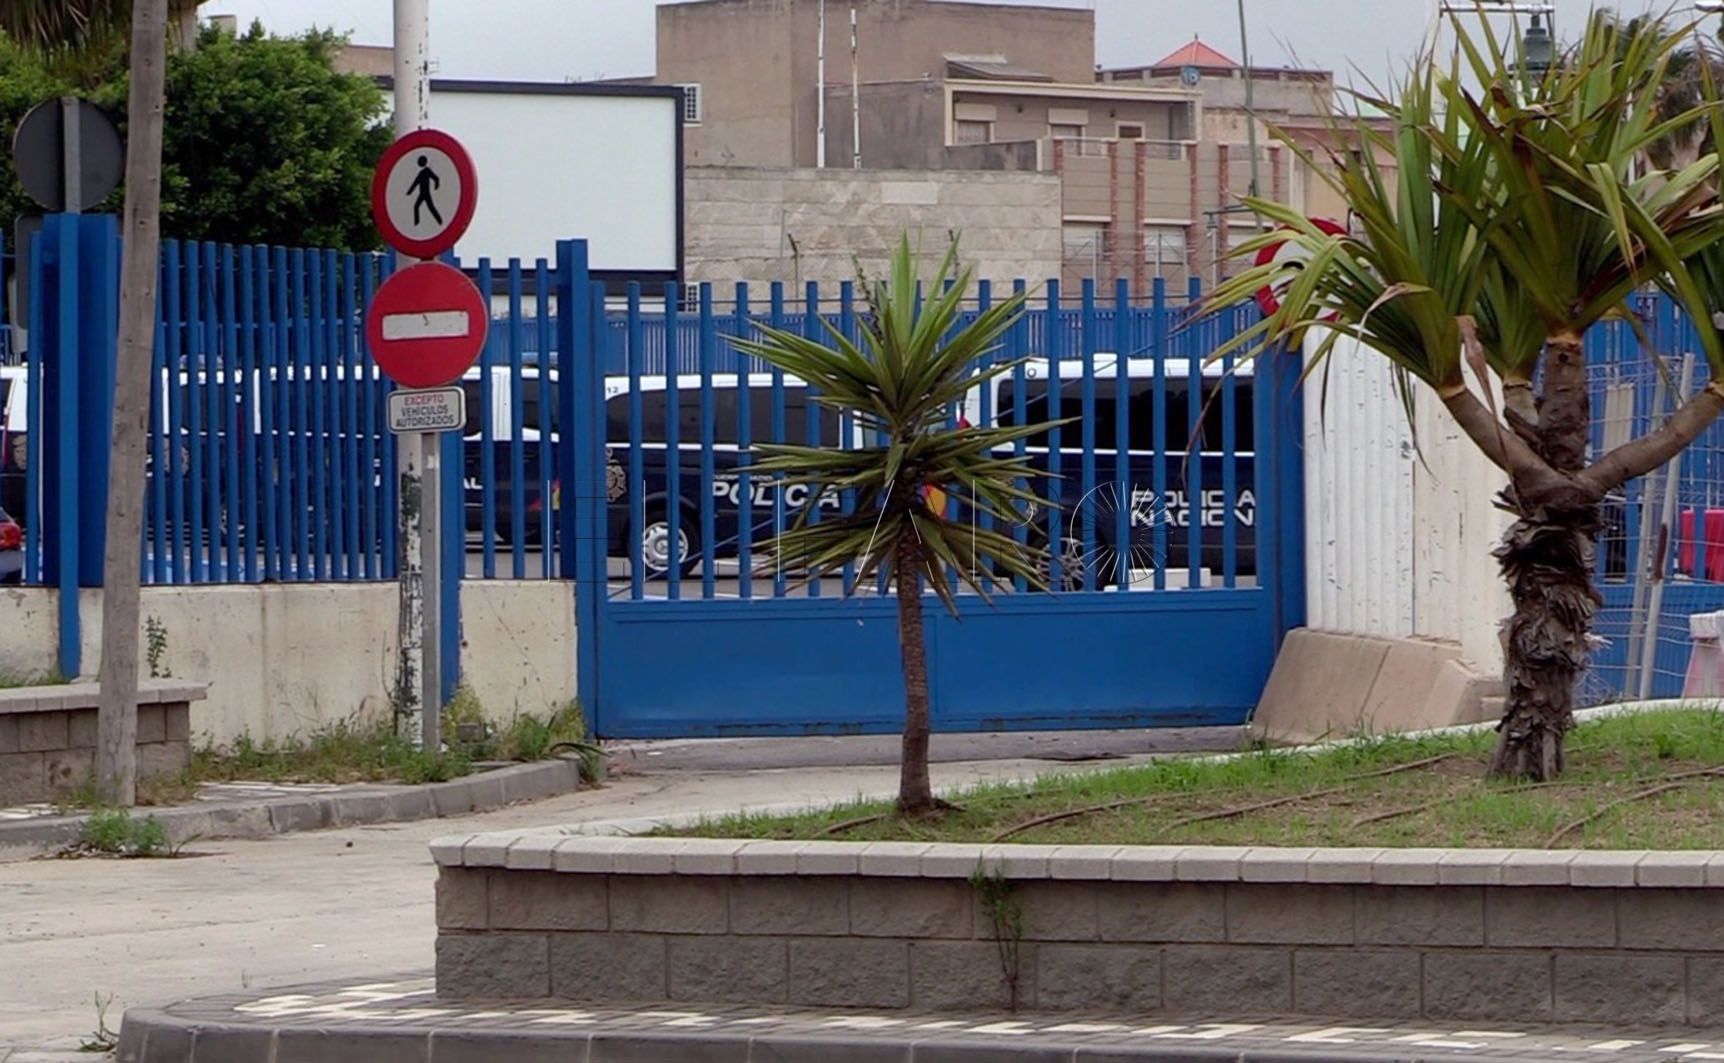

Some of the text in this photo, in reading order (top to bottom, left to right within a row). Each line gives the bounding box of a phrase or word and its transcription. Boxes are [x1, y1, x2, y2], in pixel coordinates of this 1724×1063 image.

[404, 394, 445, 406] EXCEPTO
[401, 404, 448, 417] VEHICULOS
[396, 414, 454, 427] AUTORIZADOS
[711, 481, 840, 508] POLCA
[1130, 489, 1256, 508] POLICA
